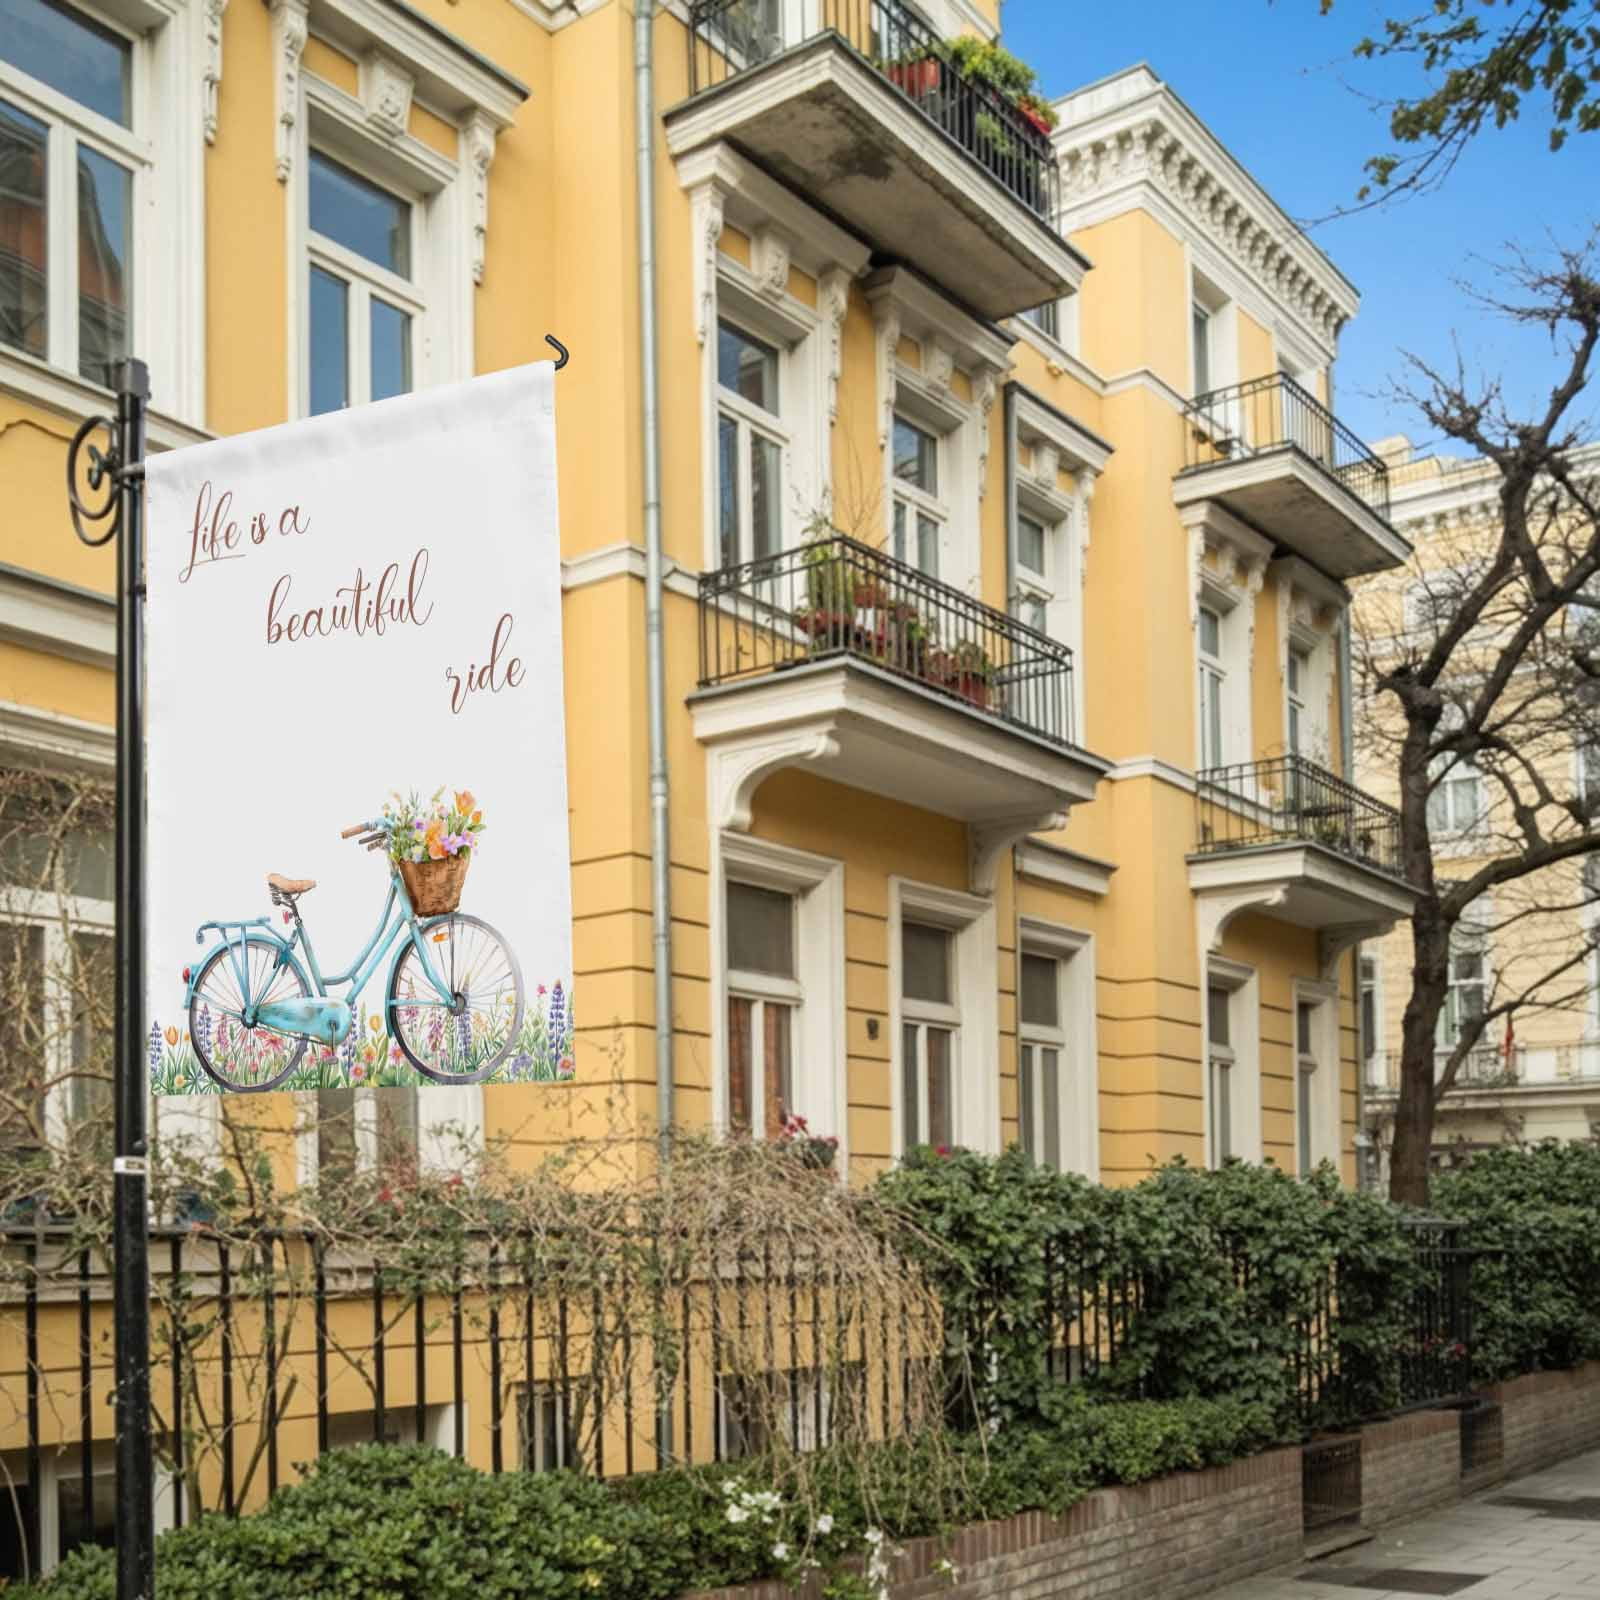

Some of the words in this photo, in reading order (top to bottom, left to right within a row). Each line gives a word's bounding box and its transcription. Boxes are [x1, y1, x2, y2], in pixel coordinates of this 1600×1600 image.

[178, 480, 246, 584] Life
[250, 512, 271, 545] is
[278, 504, 311, 536] a
[266, 548, 434, 646] beautiful
[445, 613, 527, 715] ride
